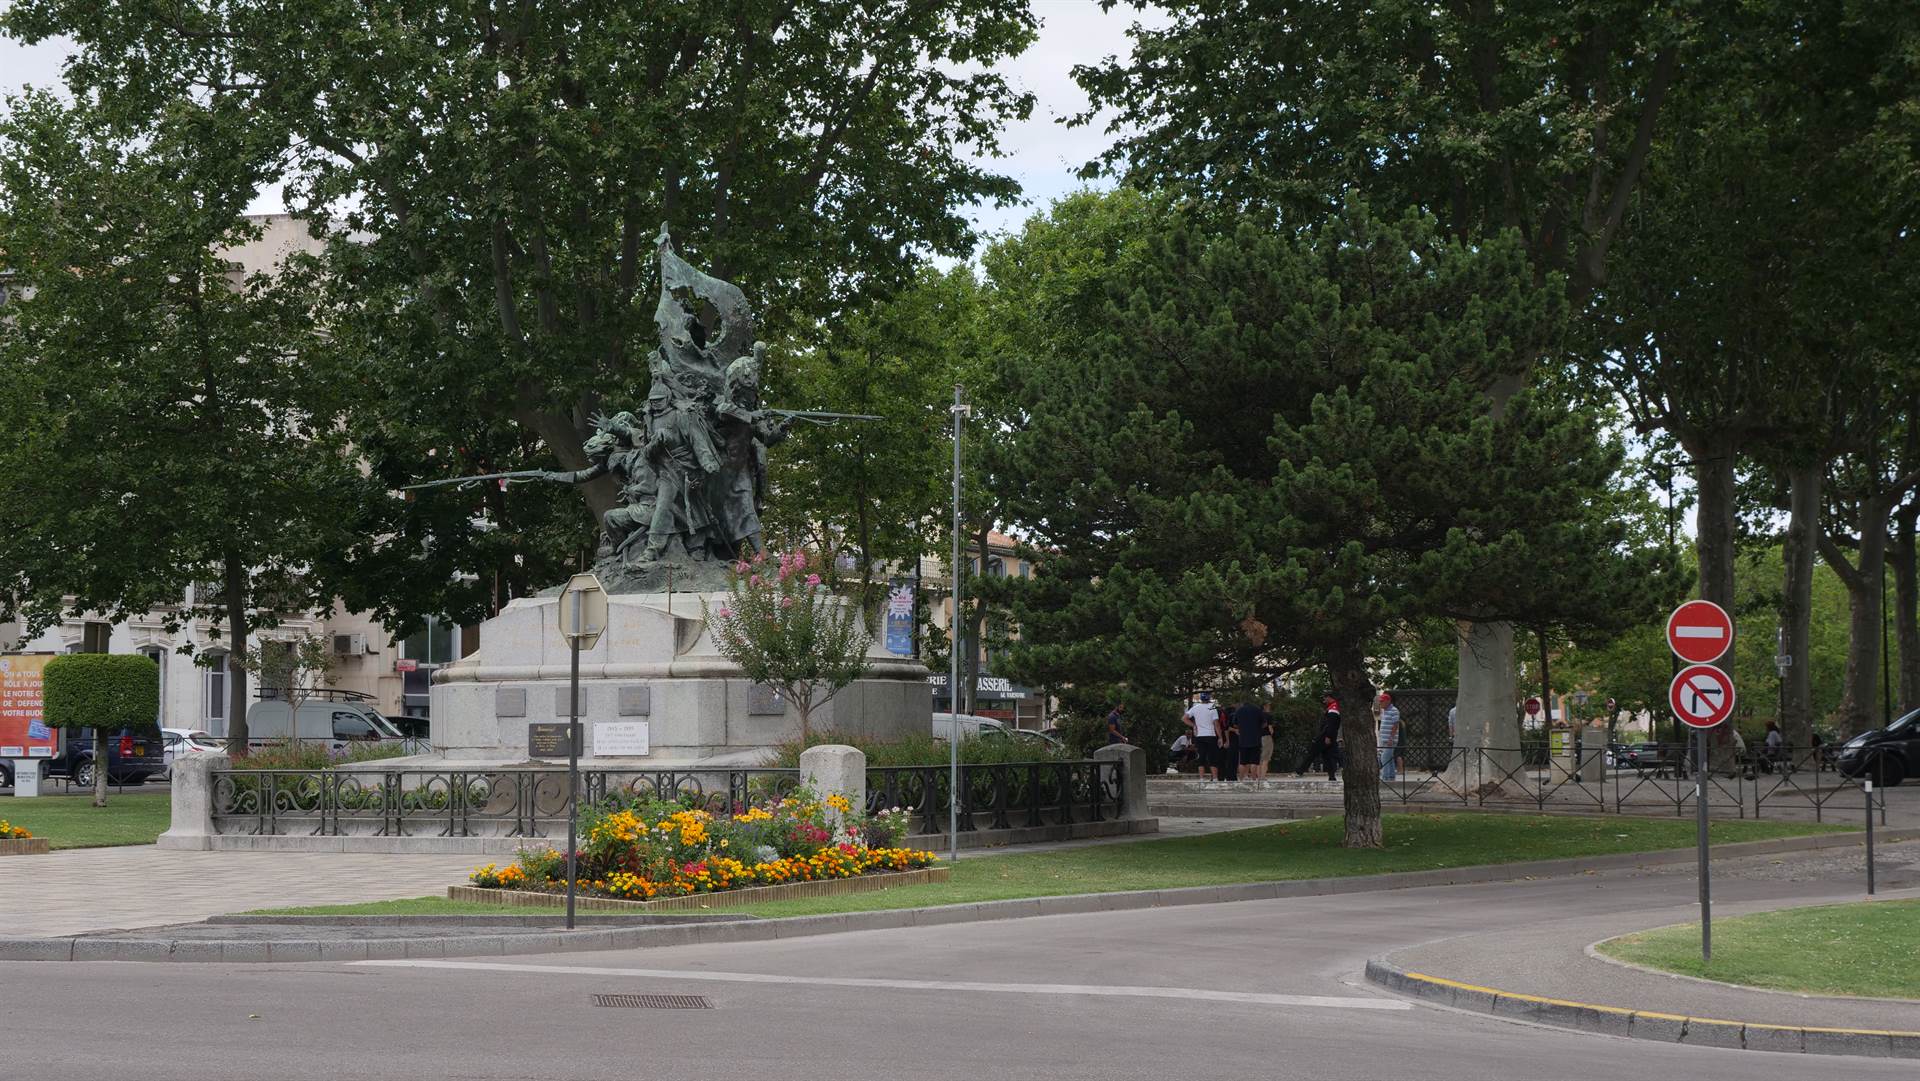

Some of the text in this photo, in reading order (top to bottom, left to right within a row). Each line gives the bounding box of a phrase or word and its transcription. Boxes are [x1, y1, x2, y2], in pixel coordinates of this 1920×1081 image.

[29, 680, 44, 688] JOU
[976, 678, 1012, 692] ASSERIE
[12, 690, 35, 698] NOTRE
[2, 710, 25, 718] VOTRE
